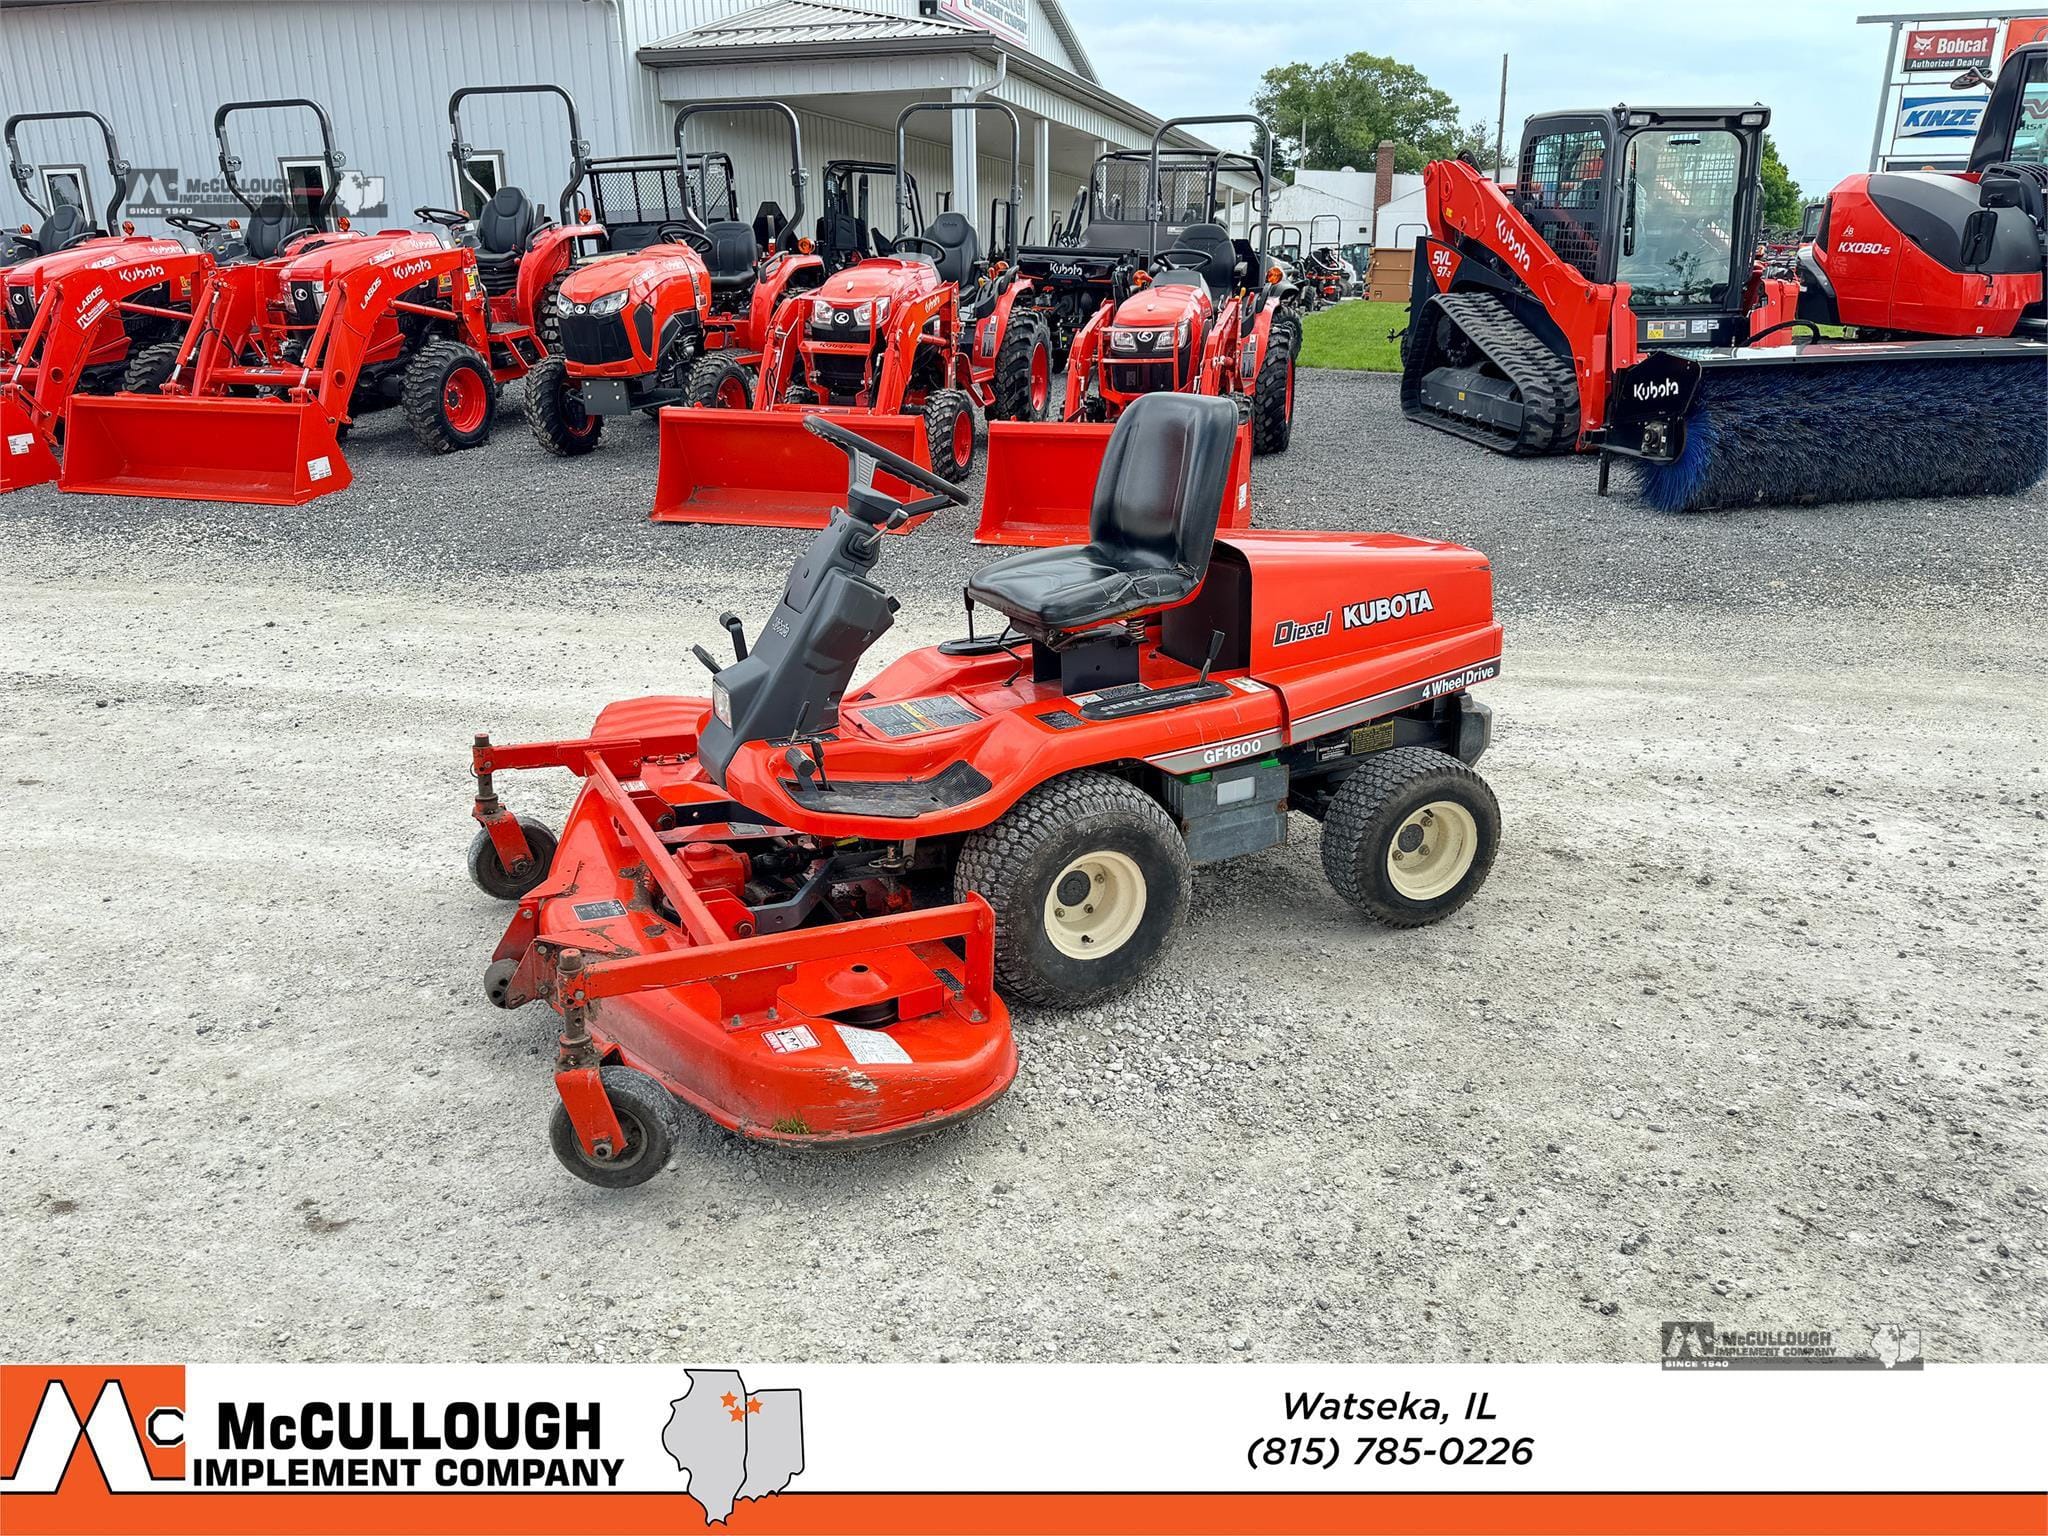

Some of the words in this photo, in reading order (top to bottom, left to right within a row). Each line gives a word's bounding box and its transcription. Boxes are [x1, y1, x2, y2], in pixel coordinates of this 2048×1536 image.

[1937, 37, 1988, 54] Bobcat
[1911, 59, 1954, 69] Authorized
[1957, 58, 1984, 67] Dealer
[1903, 109, 1983, 127] KINZE
[1495, 213, 1531, 272] Kubota
[1432, 250, 1452, 266] SVL
[119, 264, 164, 282] Kubota
[393, 259, 431, 279] Kubota
[1050, 263, 1082, 276] Kubota
[76, 285, 104, 314] LA805
[1633, 377, 1679, 401] Kubota
[1273, 610, 1332, 647] Diesel
[1343, 589, 1433, 630] KUBOTA
[1422, 684, 1431, 699] 4
[1432, 673, 1465, 696] Wheel
[1466, 667, 1494, 685] Drive
[1203, 739, 1261, 765] GF1800
